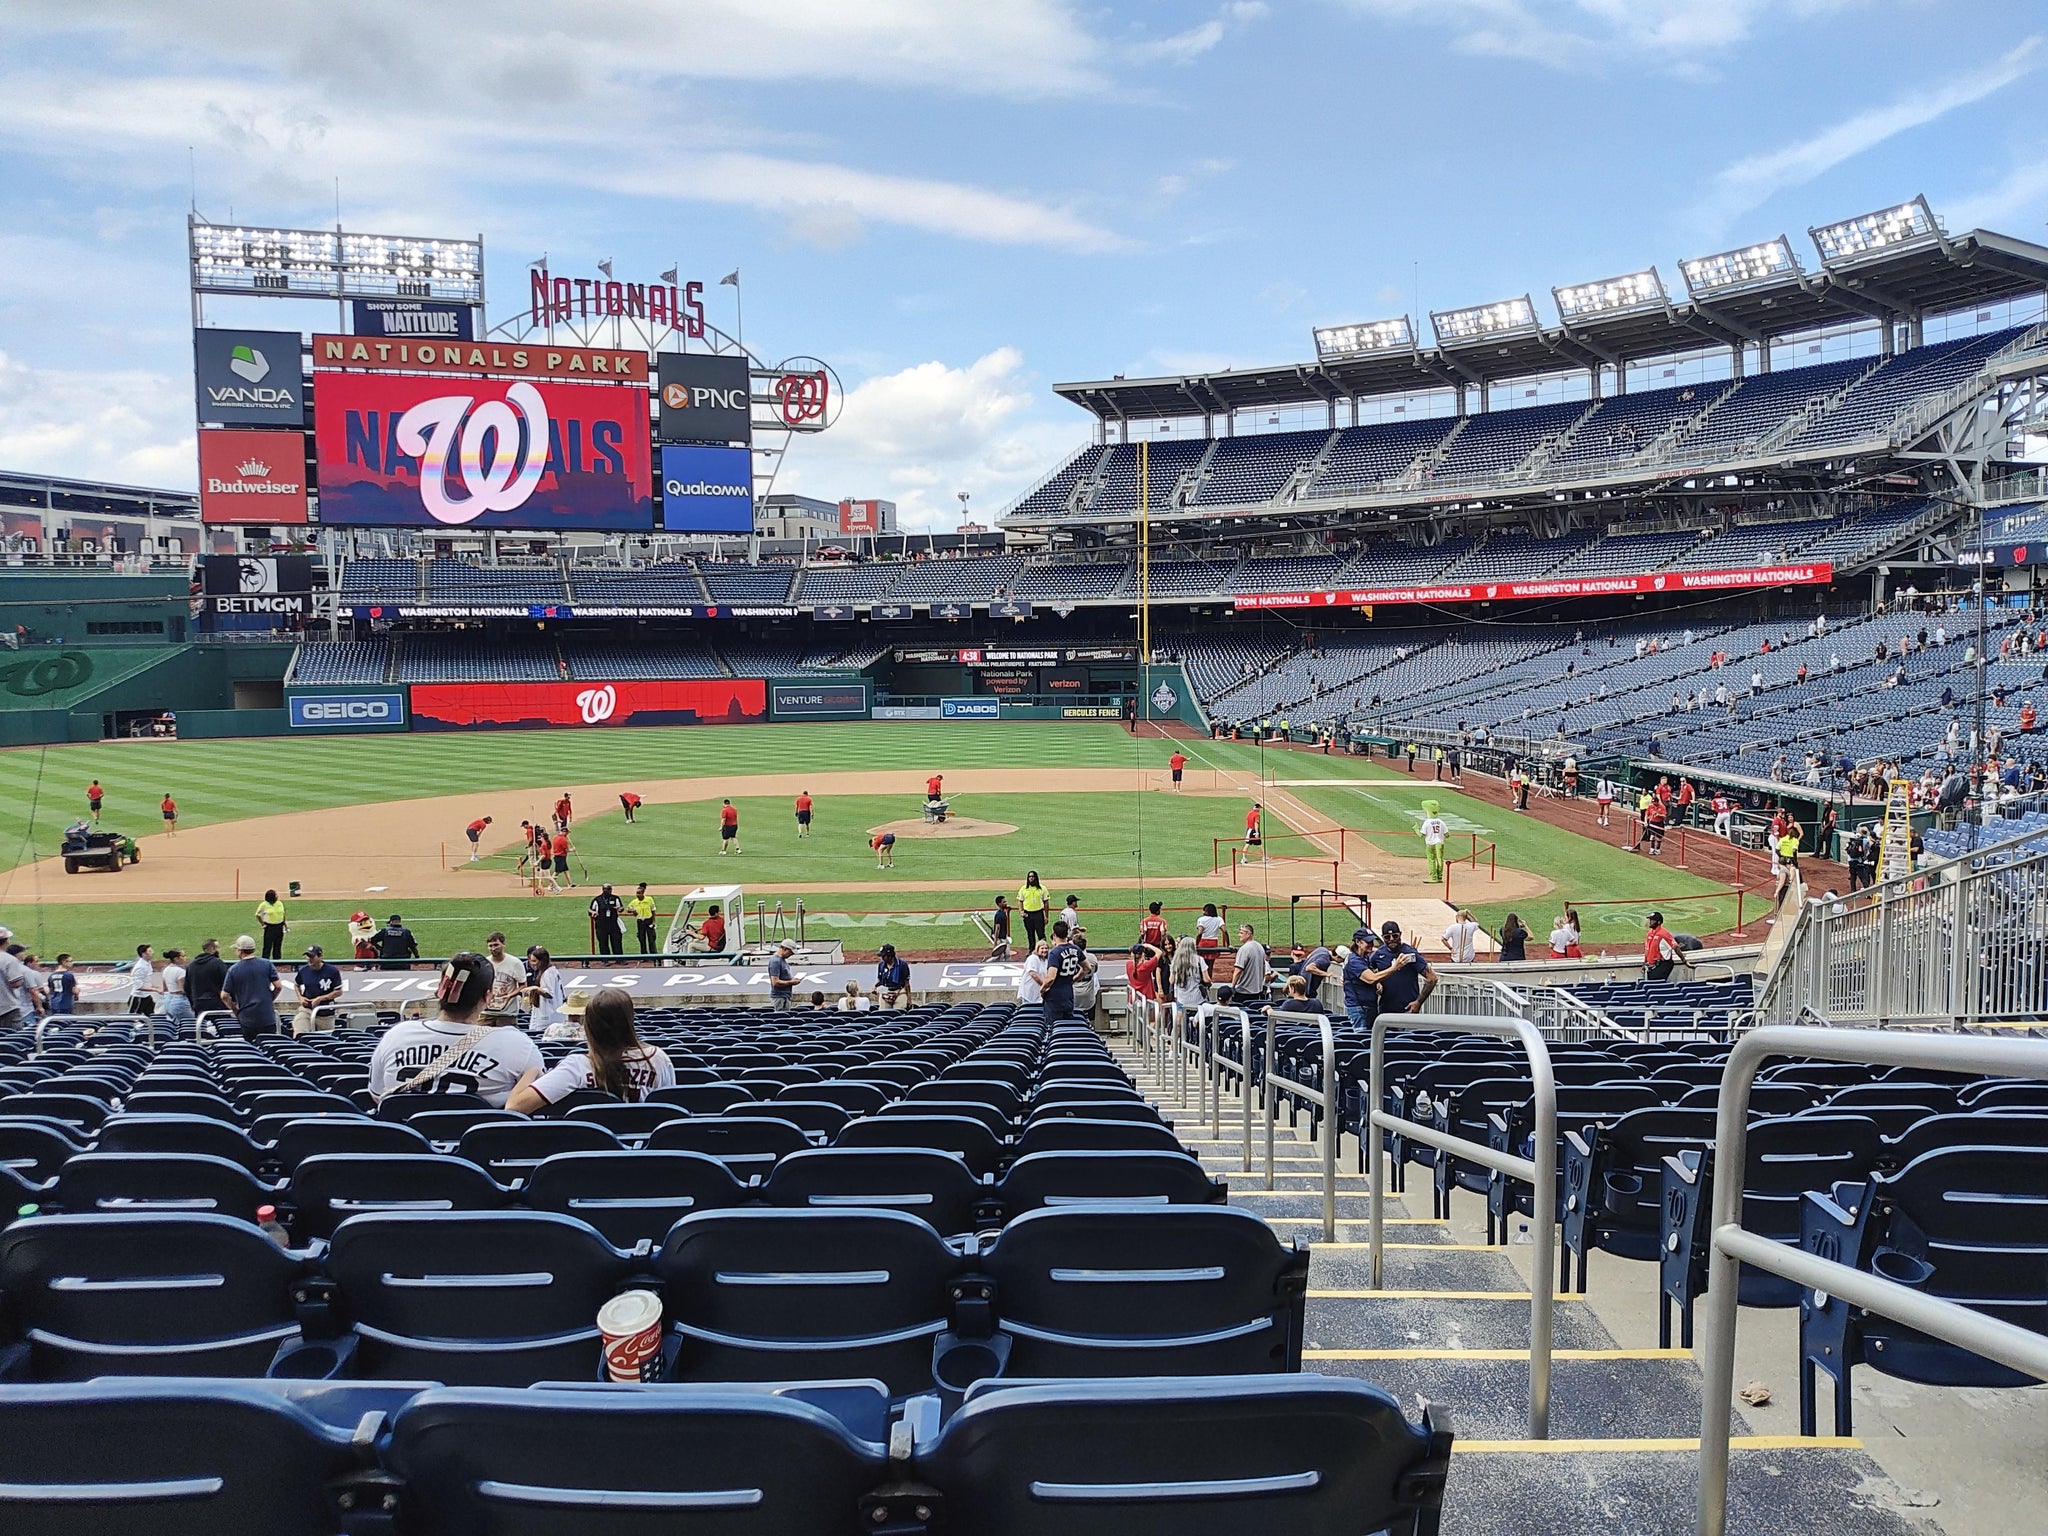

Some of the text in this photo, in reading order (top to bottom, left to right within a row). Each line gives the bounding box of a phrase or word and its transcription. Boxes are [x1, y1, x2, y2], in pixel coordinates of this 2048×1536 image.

[367, 303, 422, 311] SHOW SOME
[530, 269, 705, 338] NATIONALS
[384, 312, 459, 333] NATITUDE
[326, 341, 632, 374] NATIONALS PARK
[207, 387, 295, 403] VANDA
[691, 386, 747, 411] PNC
[207, 478, 299, 495] Budweiser
[666, 480, 749, 497] Qualcomm
[1683, 569, 1814, 587] WASHINGTON NATIONALS
[1512, 580, 1638, 595] WASHINGTON NATIONALS
[1259, 594, 1310, 605] NATIONALS
[1351, 589, 1471, 602] WASHINGTON NATIONALS
[216, 597, 303, 613] BETMGM
[399, 608, 529, 617] WASHINGTON NATIONALS
[572, 608, 692, 616] WASHINGTON NATIONALS
[732, 608, 792, 616] WASHINGTON
[986, 678, 1028, 686] powered by
[1049, 680, 1081, 688] verizon
[779, 696, 823, 704] VENTURE
[302, 701, 389, 719] GEICO
[957, 705, 997, 713] DABOS
[1064, 709, 1120, 717] HERCULES FENCE
[1060, 957, 1079, 976] 99
[395, 1044, 499, 1078] RODRUEZ
